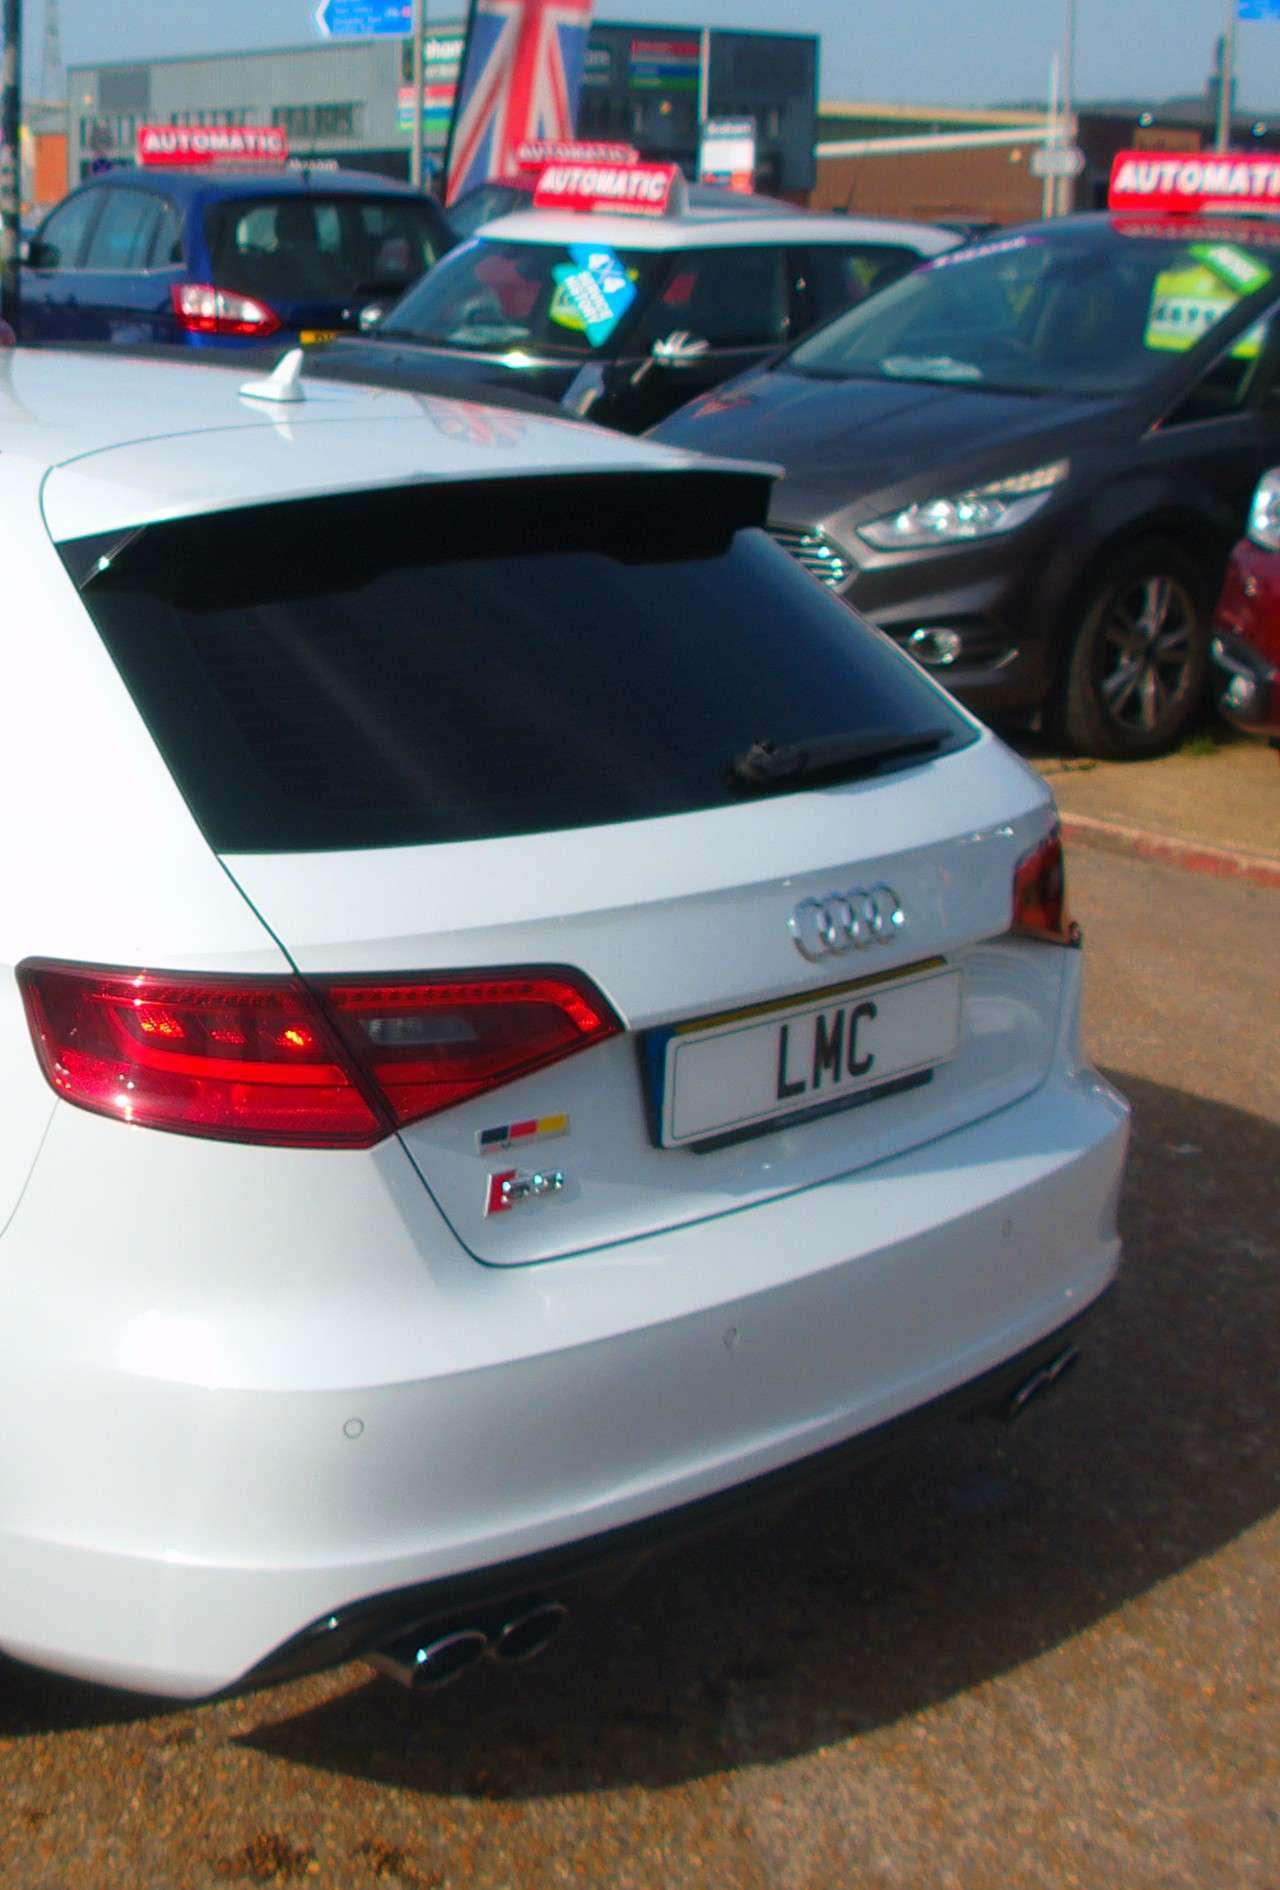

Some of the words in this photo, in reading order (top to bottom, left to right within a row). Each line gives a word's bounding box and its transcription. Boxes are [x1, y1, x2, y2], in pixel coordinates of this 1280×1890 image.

[145, 133, 284, 152] AUTOMATIC
[539, 165, 668, 201] AUTOMATIC
[1114, 160, 1280, 197] AUTOMATI
[776, 1001, 878, 1100] LMC
